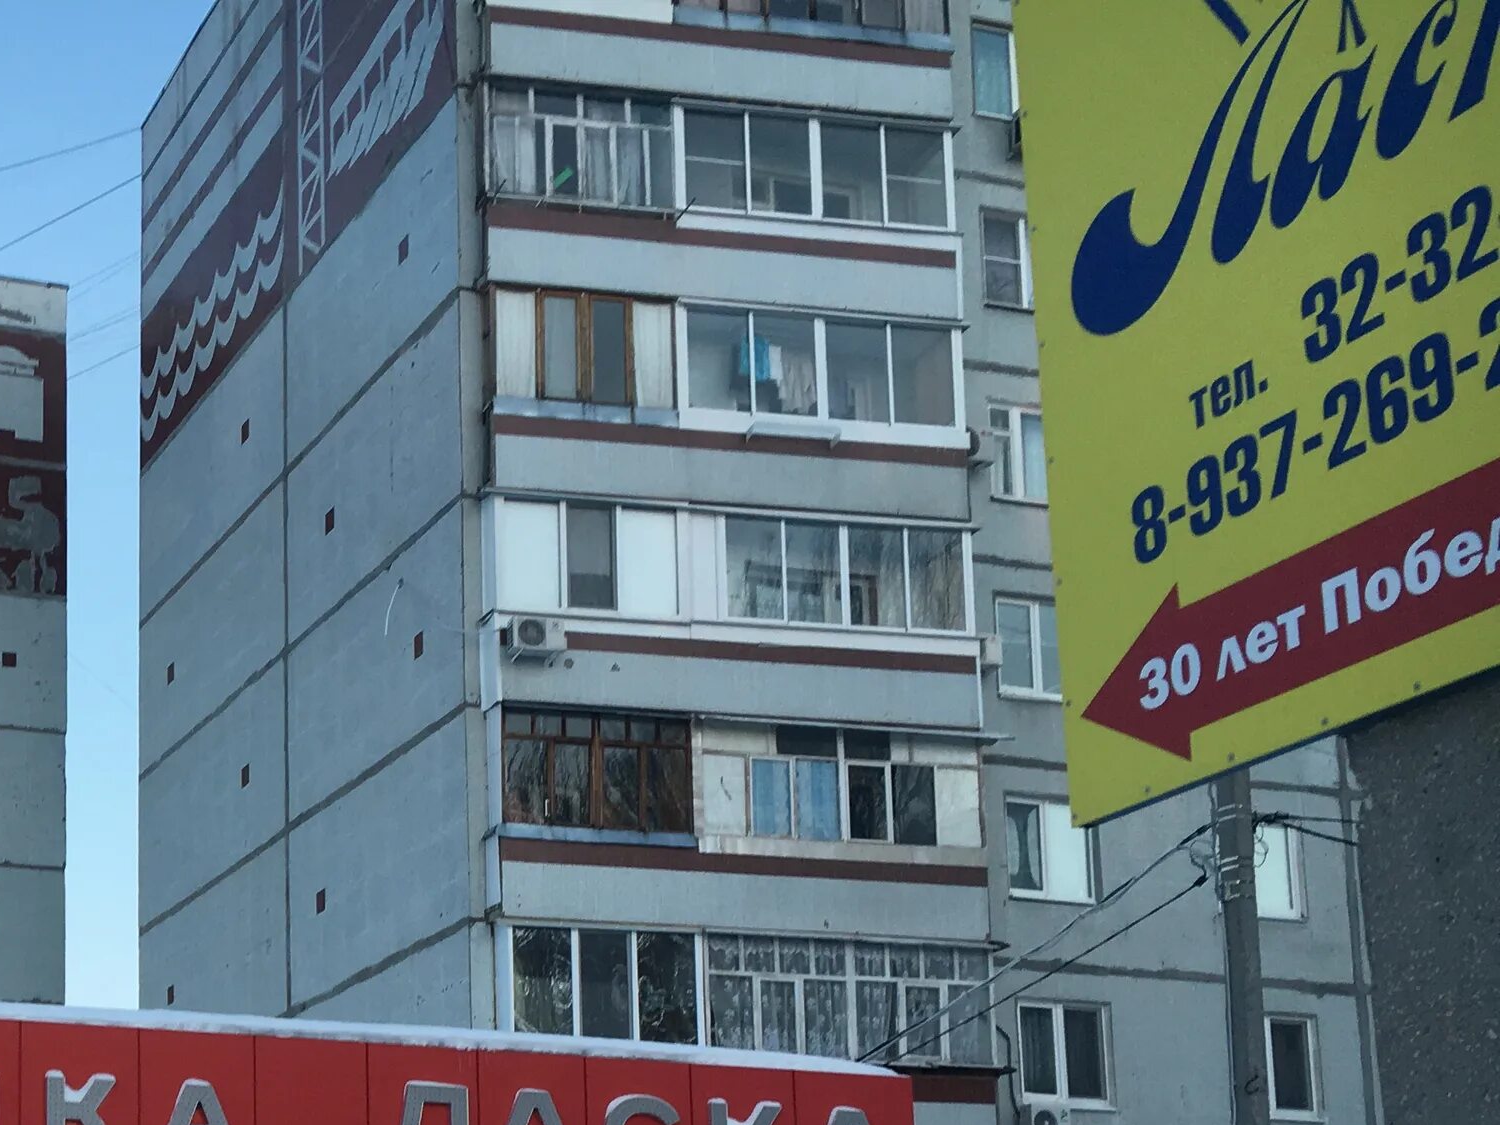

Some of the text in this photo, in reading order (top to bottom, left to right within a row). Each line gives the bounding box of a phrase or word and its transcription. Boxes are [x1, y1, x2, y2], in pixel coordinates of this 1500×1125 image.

[1189, 185, 1500, 429] тел. 32-32
[1139, 643, 1201, 710] 30
[1216, 604, 1306, 681] лет
